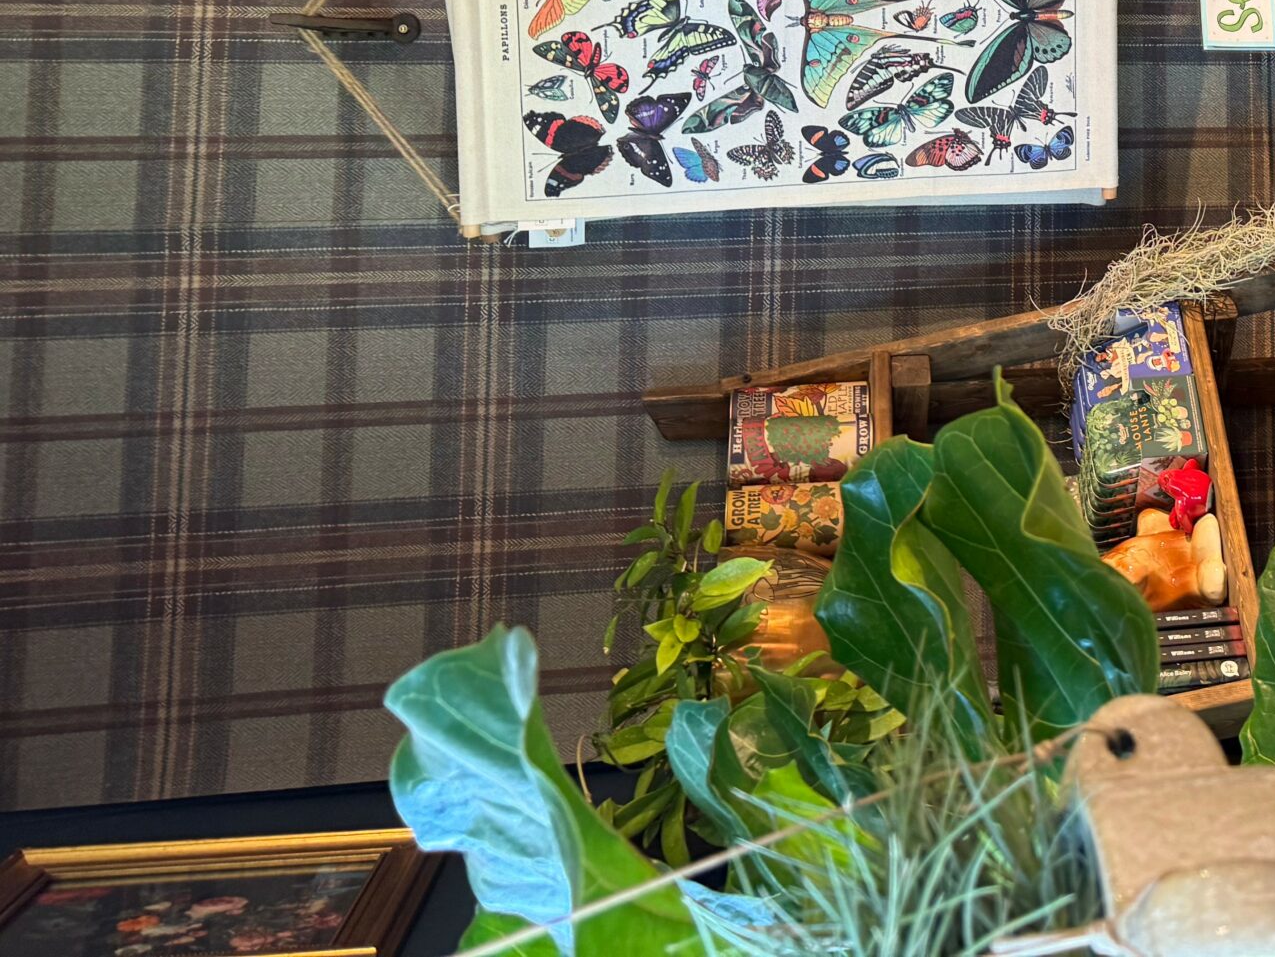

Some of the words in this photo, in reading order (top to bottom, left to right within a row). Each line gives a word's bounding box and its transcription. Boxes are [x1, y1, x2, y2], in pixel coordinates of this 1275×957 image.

[499, 3, 510, 62] PAPILLONS
[736, 392, 750, 417] ROW
[828, 396, 837, 415] ED
[858, 420, 870, 454] GROW
[1138, 406, 1152, 441] LANTS
[732, 491, 745, 526] GROW
[747, 490, 761, 515] TREE!
[747, 516, 760, 526] A
